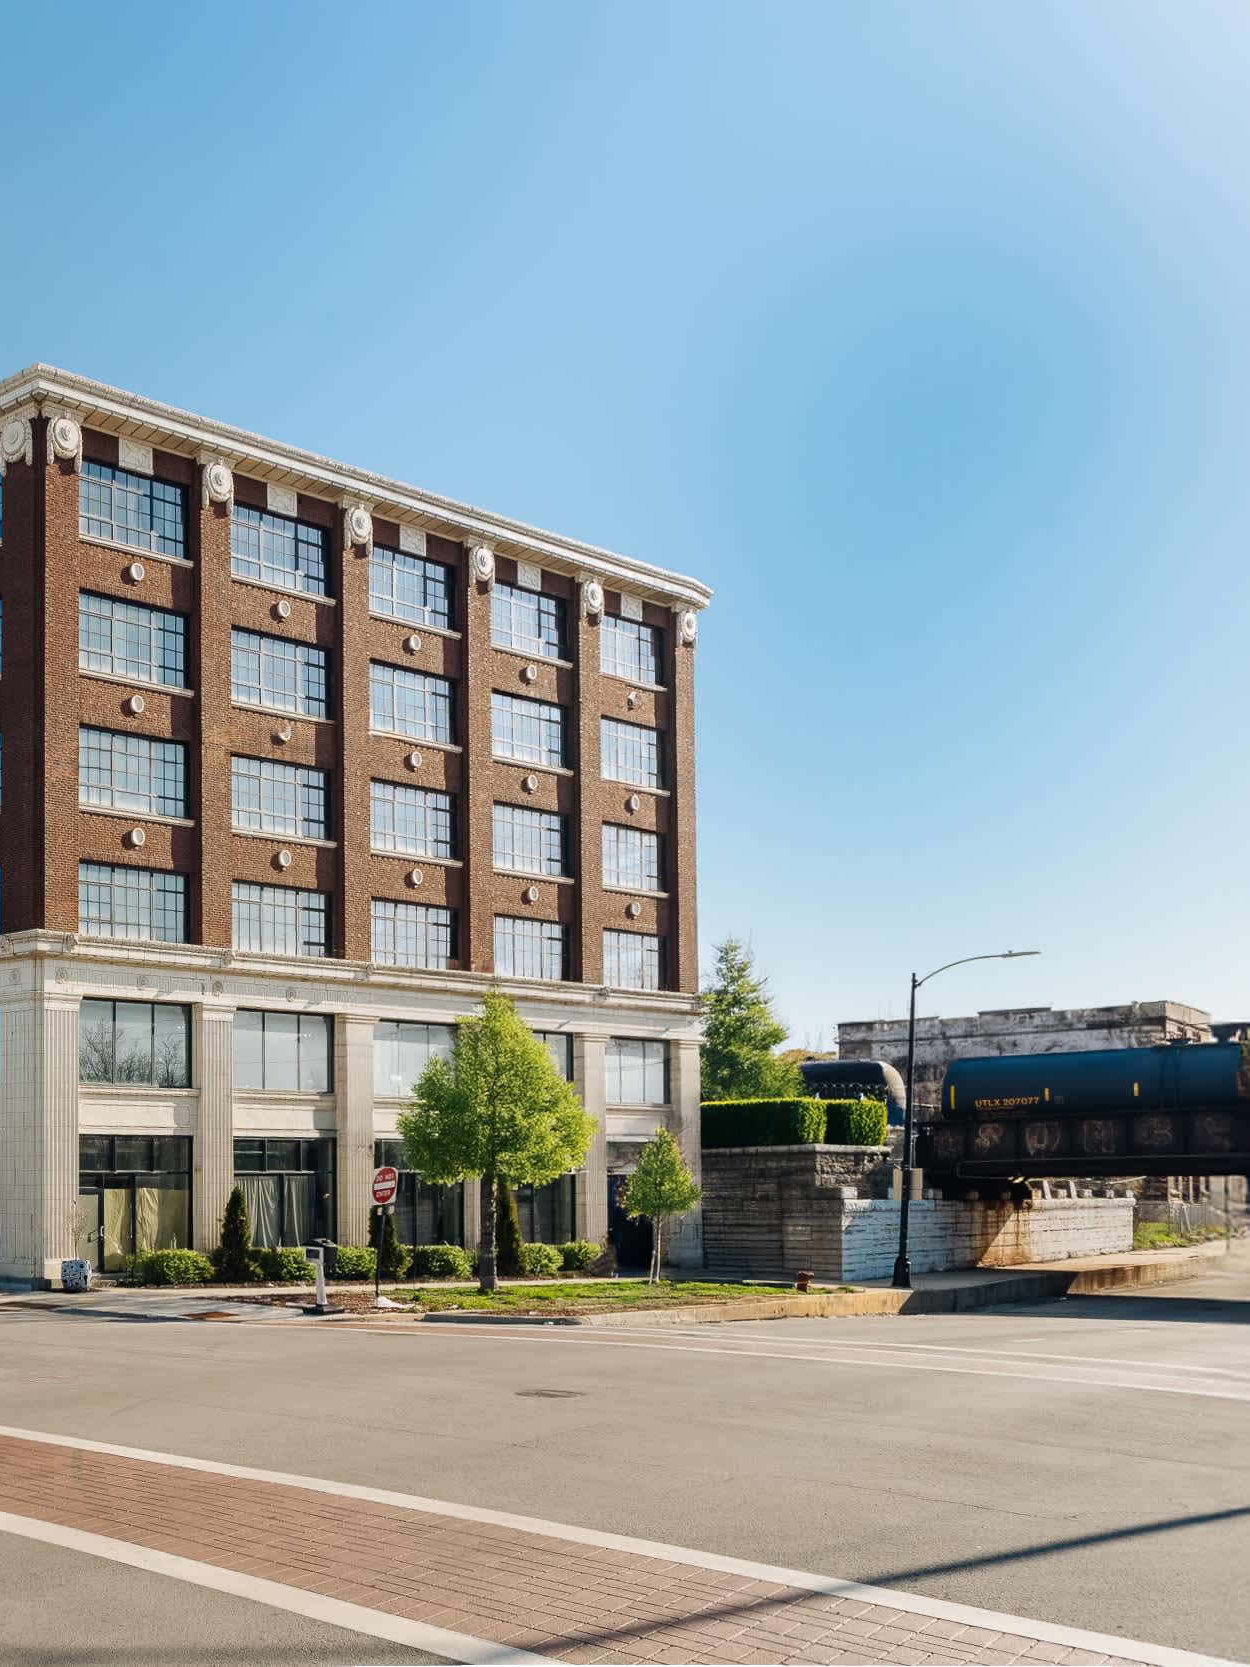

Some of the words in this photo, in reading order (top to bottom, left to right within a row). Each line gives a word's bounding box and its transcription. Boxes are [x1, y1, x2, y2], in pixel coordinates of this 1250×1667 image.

[974, 1098, 1001, 1108] UTLX
[1003, 1096, 1039, 1106] 207077
[376, 1189, 391, 1198] ENTER
